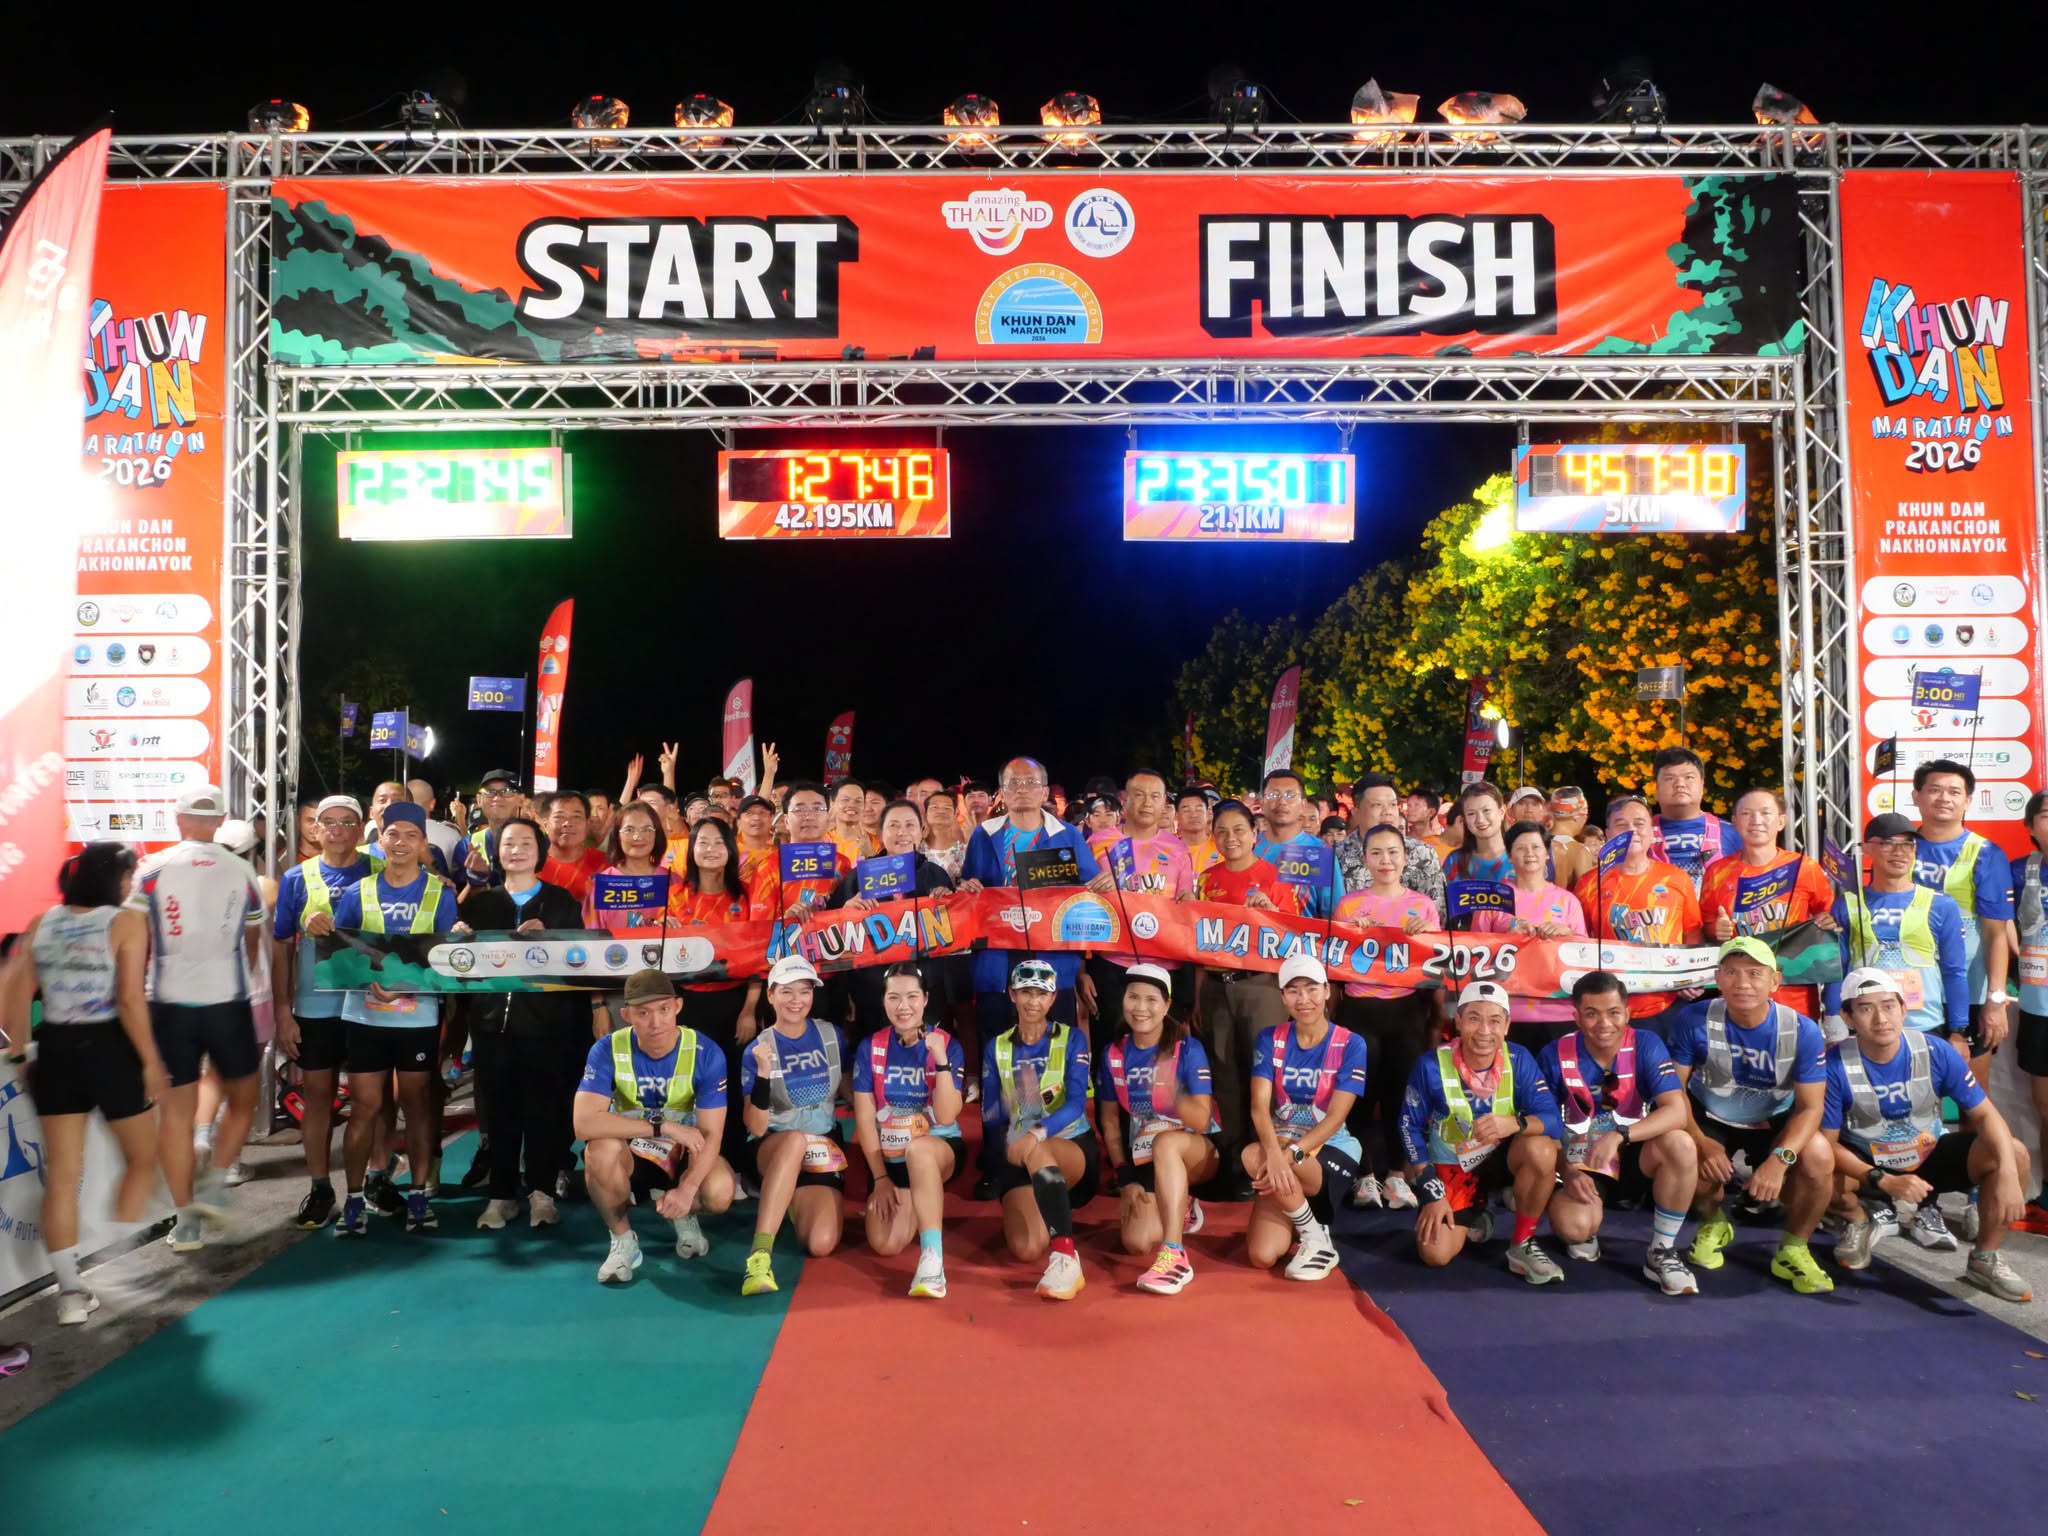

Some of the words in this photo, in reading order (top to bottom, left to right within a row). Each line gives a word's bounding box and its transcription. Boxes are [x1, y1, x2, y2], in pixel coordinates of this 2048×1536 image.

[974, 194, 1021, 206] amazing
[949, 207, 1048, 222] THAILAND
[524, 223, 838, 319] START
[1208, 221, 1536, 318] FINISH
[980, 292, 996, 335] EVERY
[998, 268, 1031, 290] STEP
[1039, 268, 1065, 281] HAS
[1070, 281, 1078, 289] A
[1081, 291, 1099, 334] STORY
[1001, 316, 1042, 326] KHUN
[1046, 315, 1077, 326] DAN
[1860, 277, 2010, 357] KHUN
[1010, 327, 1066, 335] MARATHON
[1867, 345, 2005, 413] DAN
[1871, 414, 2013, 440] MARATHON
[83, 430, 205, 456] ARATHON
[1905, 439, 1982, 473] 2026
[788, 455, 934, 503] 1:27:46
[1565, 451, 1731, 497] 4:57:38
[774, 503, 893, 528] 42.195KM
[1199, 504, 1282, 530] 21.1KM
[1605, 498, 1661, 523] 5KM
[1898, 502, 1944, 517] KHUN
[1951, 502, 1985, 517] DAN
[138, 519, 173, 534] DAN
[1885, 520, 2001, 535] PRAKANCHON
[81, 537, 186, 553] RAKANCHON
[1880, 538, 2008, 553] NAKHONNAYOK
[77, 556, 193, 571] AKHONNAYOK
[1638, 681, 1673, 692] SWEEPER
[1916, 686, 1954, 701] 3:00
[472, 690, 504, 702] 3:00
[1964, 714, 1985, 727] ptt
[141, 735, 161, 747] ptt
[791, 858, 818, 872] 2:15
[1028, 863, 1079, 880] SWEEPER
[864, 872, 898, 890] 2:45
[1122, 872, 1167, 892] HUN
[603, 889, 638, 903] 2:15
[1459, 893, 1501, 906] 2:00
[1741, 882, 1778, 905] 2:30
[1610, 903, 1667, 929] KHUN
[863, 904, 954, 954] DAN
[1090, 922, 1106, 931] DAN
[766, 921, 866, 964] KHUN
[1196, 917, 1410, 974] MARATHON
[1422, 943, 1519, 981] 2026
[1134, 1141, 1152, 1151] 2:45
[1568, 1148, 1588, 1157] 2:45
[804, 1149, 828, 1160] 5hrs
